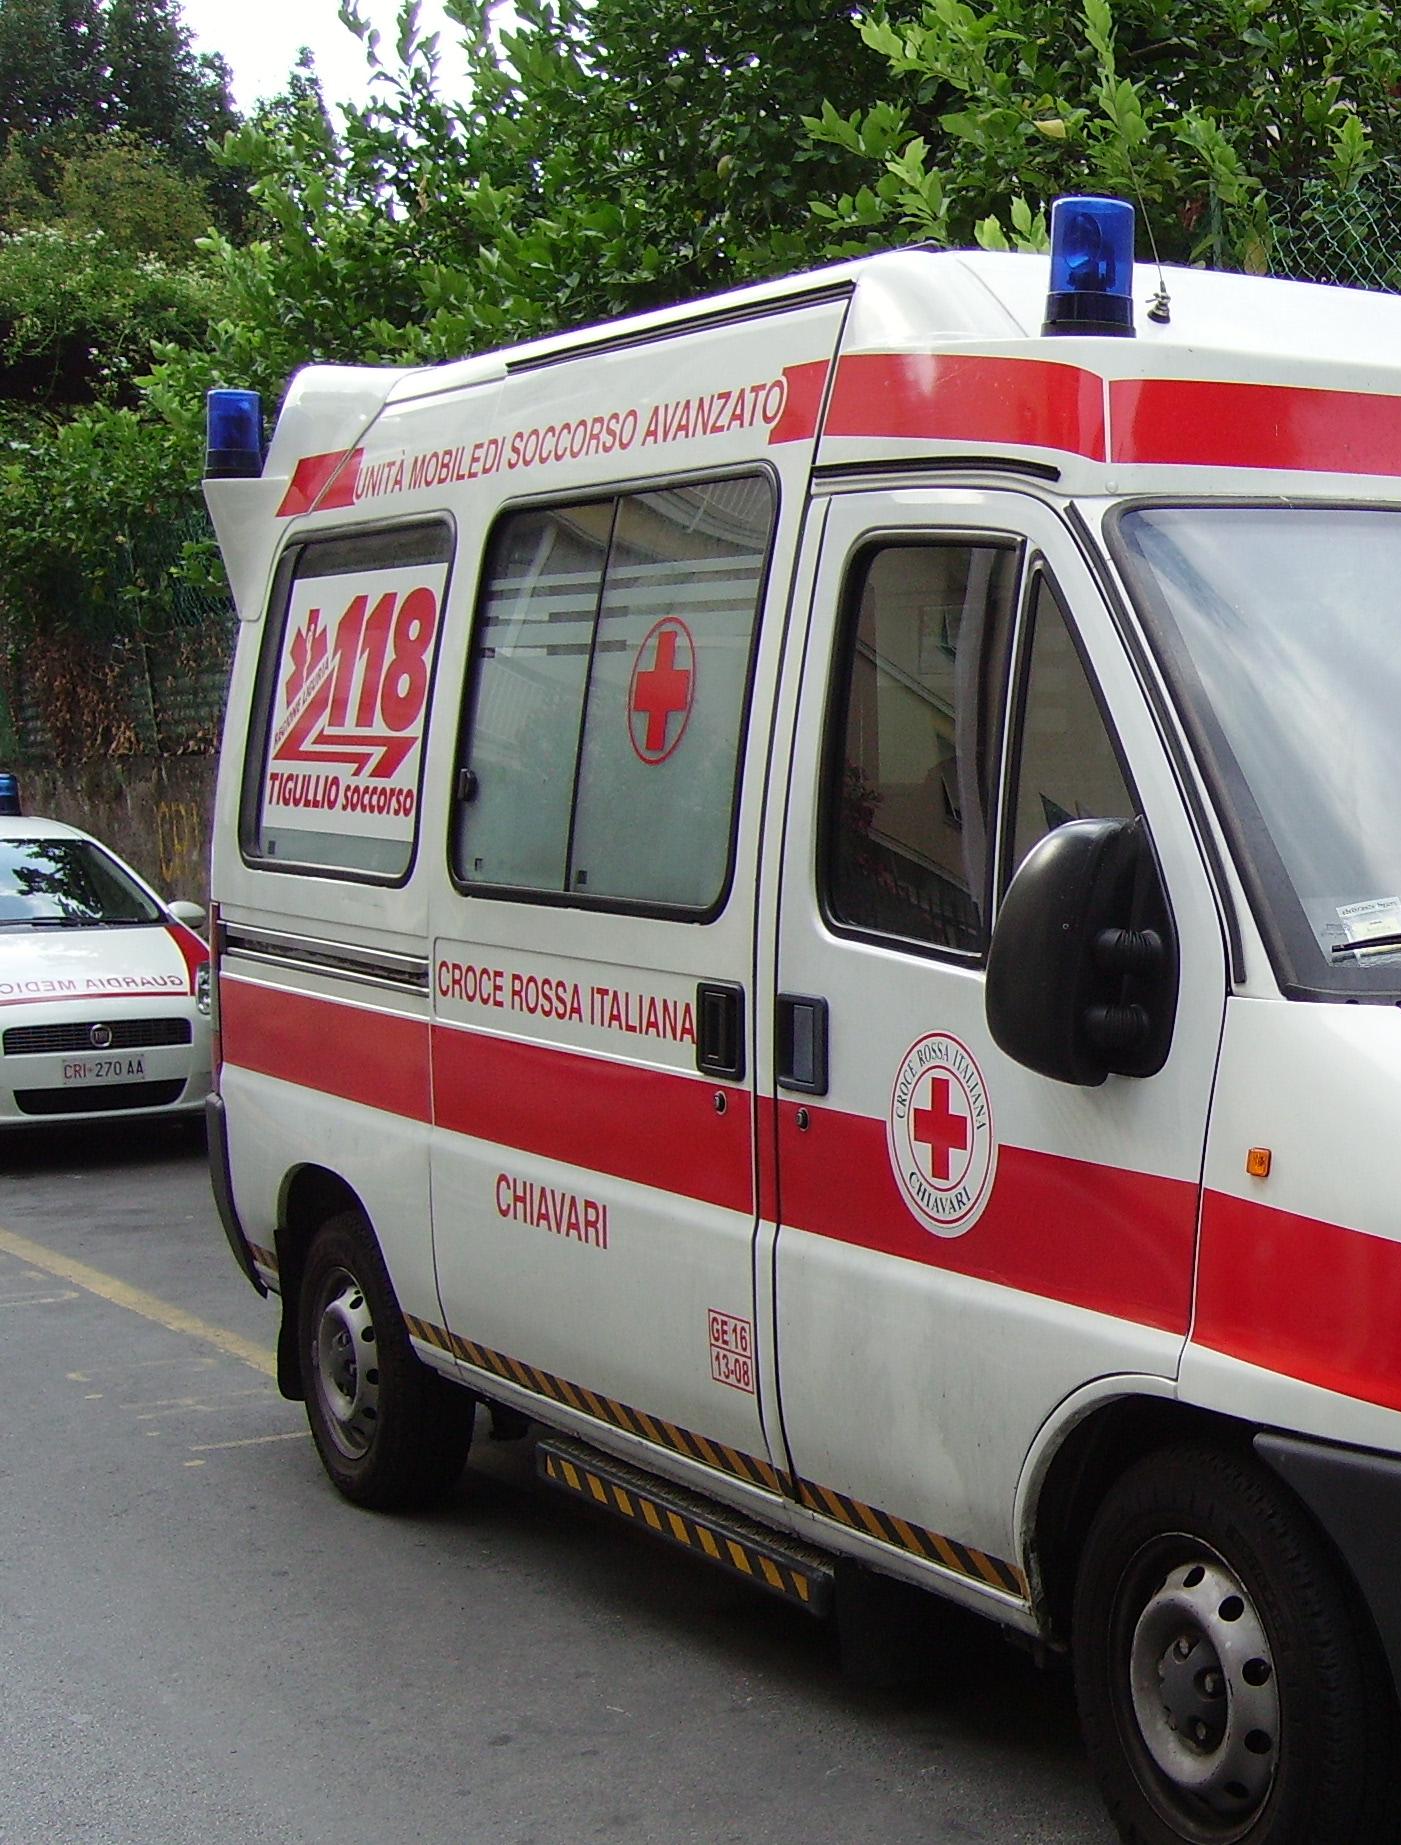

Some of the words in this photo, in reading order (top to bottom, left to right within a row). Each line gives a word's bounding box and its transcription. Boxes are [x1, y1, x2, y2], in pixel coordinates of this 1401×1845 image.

[355, 449, 405, 500] UNITÀ
[507, 408, 638, 470] SOCCORSO
[641, 379, 786, 447] AVANZATO
[328, 586, 437, 732] 118
[269, 772, 340, 811] TIGULLIO
[341, 784, 415, 817] soccorso
[437, 960, 504, 1007] CROCE
[511, 973, 583, 1024] ROSSA
[590, 986, 697, 1045] ITALIANA
[64, 1064, 87, 1079] CRI
[95, 1062, 122, 1078] 270
[127, 1060, 144, 1075] AA
[895, 1060, 918, 1119] CROCE
[916, 1042, 949, 1068] ROSSA
[952, 1049, 987, 1130] ITALIANA
[495, 1173, 609, 1250] CHIAVARI
[908, 1171, 971, 1215] CHIAVARI
[711, 1316, 729, 1346] GE
[732, 1323, 748, 1352] 16
[715, 1351, 750, 1387] 13-08
